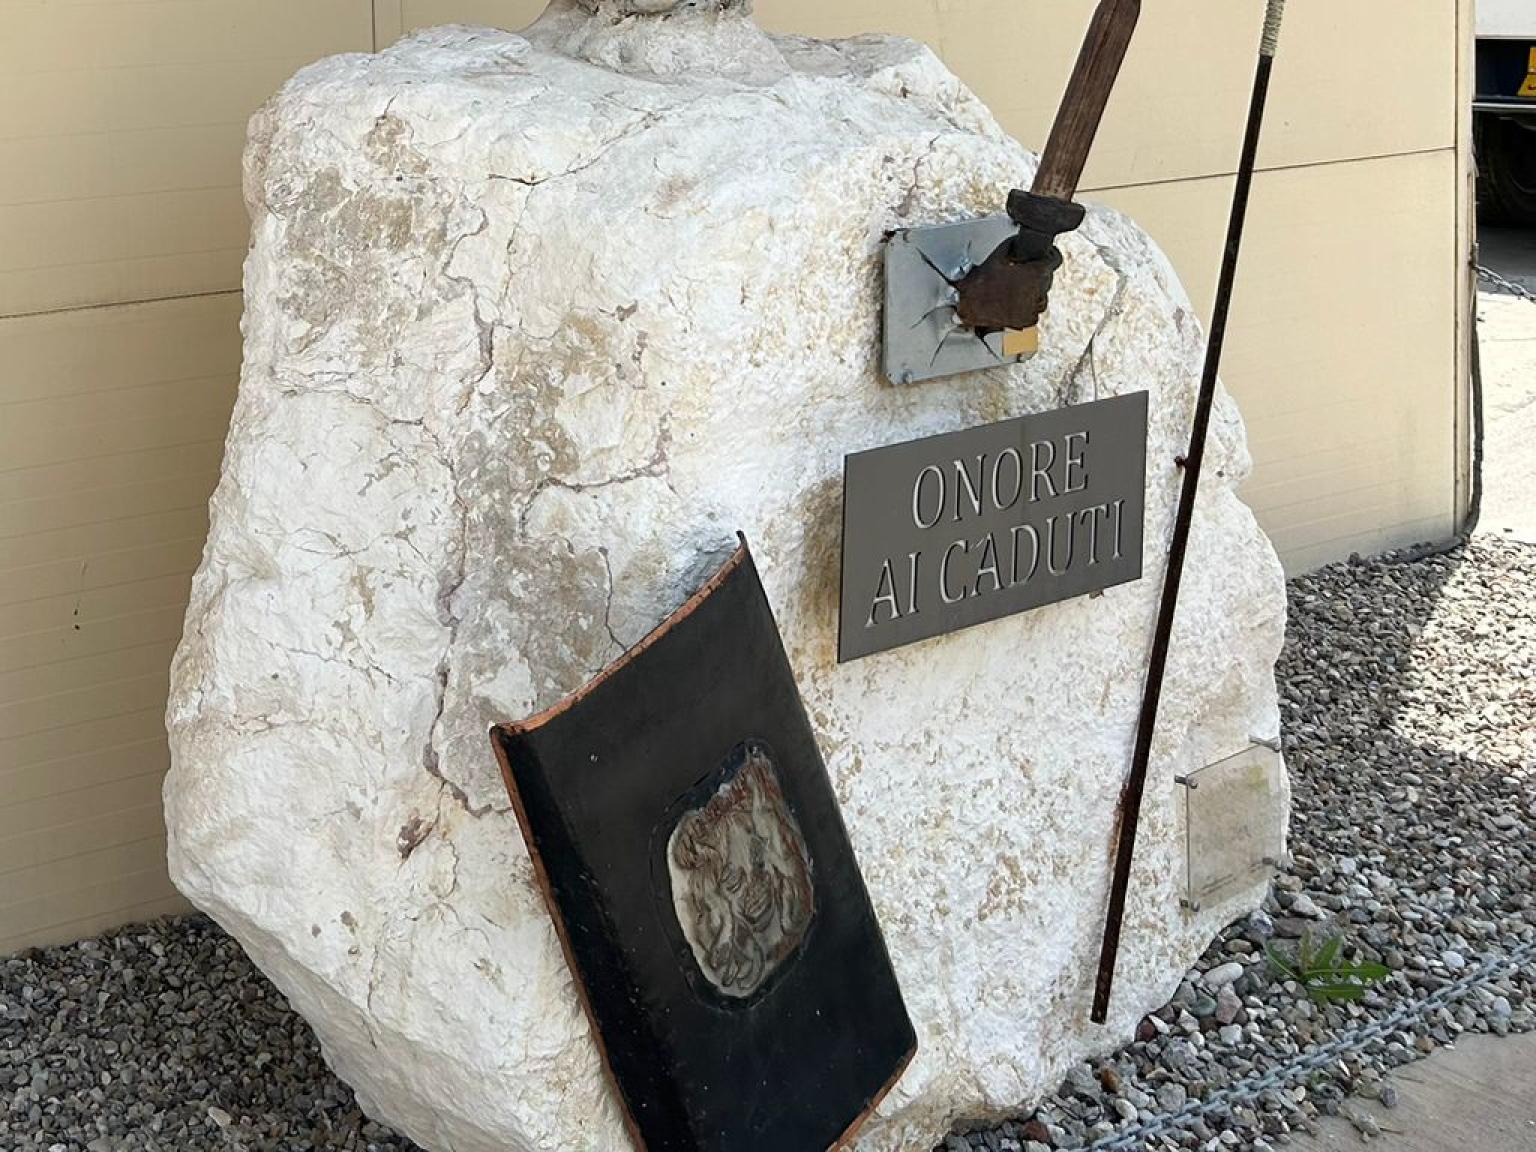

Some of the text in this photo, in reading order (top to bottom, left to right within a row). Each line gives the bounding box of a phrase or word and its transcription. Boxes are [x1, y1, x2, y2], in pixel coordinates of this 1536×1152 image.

[912, 431, 1090, 530] ONORE
[865, 499, 1125, 628] AI CADUTI
